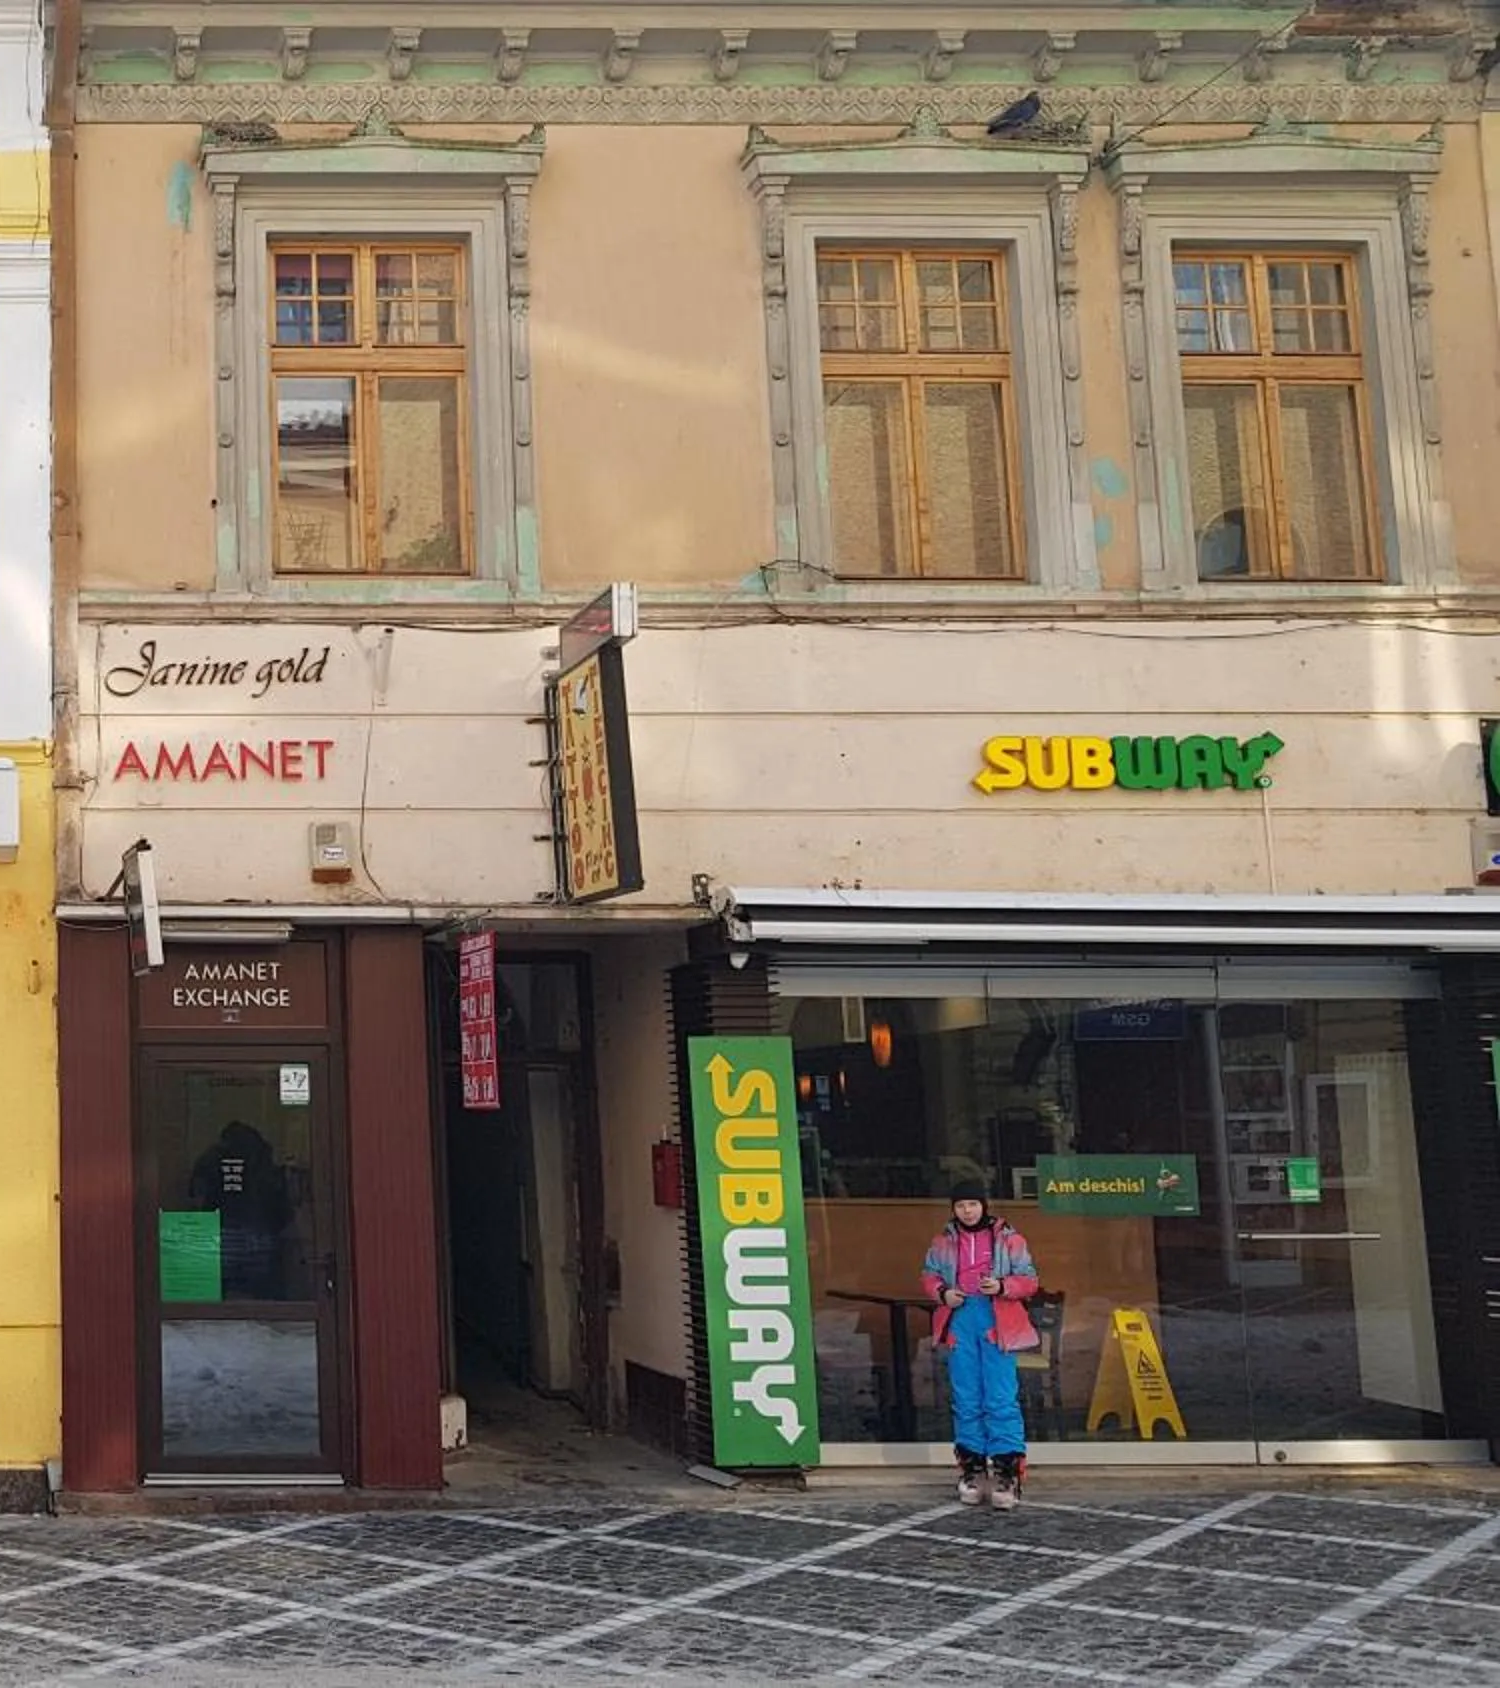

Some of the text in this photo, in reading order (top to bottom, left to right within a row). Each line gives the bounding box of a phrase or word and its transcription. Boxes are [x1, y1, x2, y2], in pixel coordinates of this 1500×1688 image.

[104, 640, 330, 698] Janine gold
[114, 741, 334, 782] AMANET
[561, 682, 585, 890] TATTOO
[972, 732, 1285, 795] SUBWAY
[184, 962, 282, 982] AMANET
[172, 988, 291, 1008] EXCHANGE
[1045, 1177, 1146, 1195] Am deschis!
[705, 1053, 806, 1446] SUBWAY
